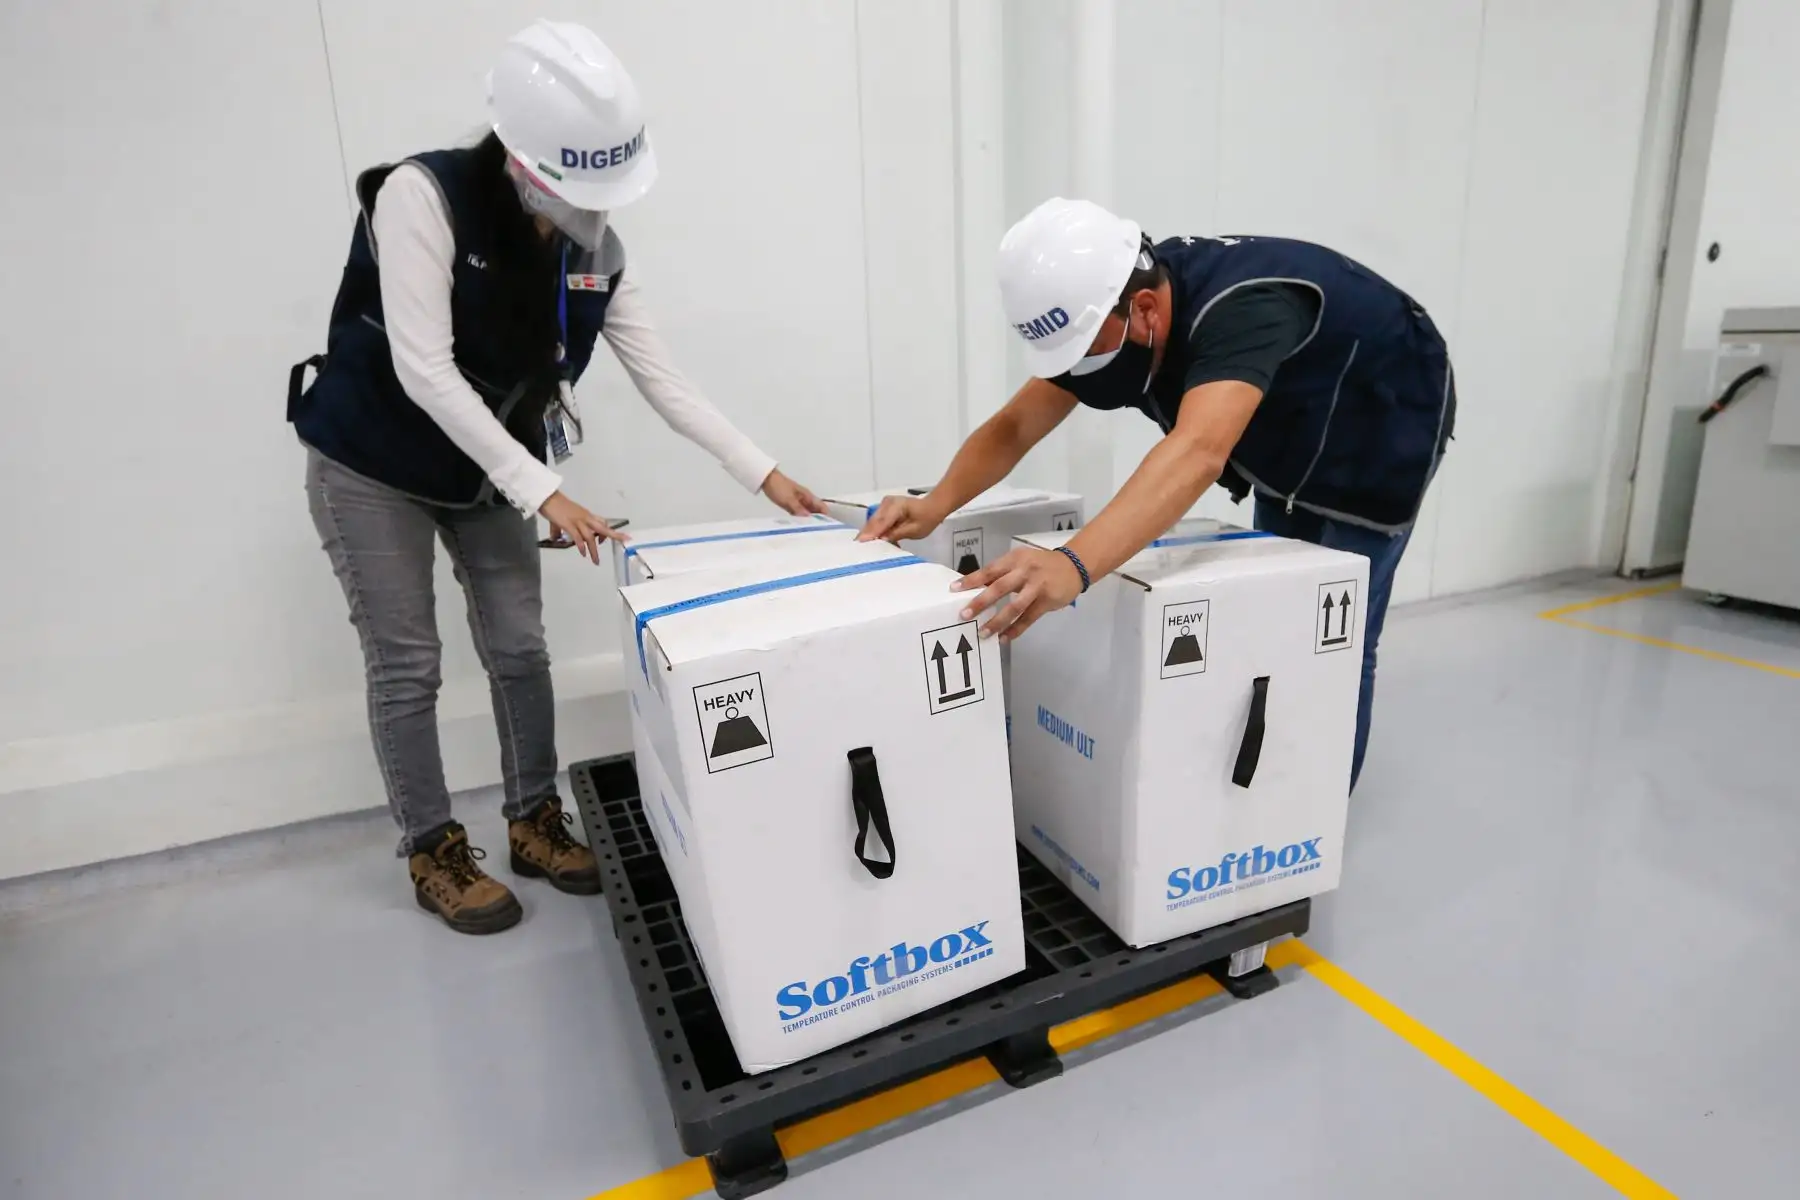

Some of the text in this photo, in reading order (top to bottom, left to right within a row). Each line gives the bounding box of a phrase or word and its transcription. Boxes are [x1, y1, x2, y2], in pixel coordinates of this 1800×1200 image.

[561, 124, 645, 169] DIGEMI
[1013, 307, 1070, 340] EMID
[956, 537, 980, 548] HEAVY
[1168, 612, 1203, 627] HEAVY
[703, 688, 754, 711] HEAVY
[1037, 703, 1074, 748] MEDIUM
[1077, 729, 1095, 761] ULT
[1167, 836, 1323, 900] Softbox
[776, 920, 993, 1021] Softbox
[782, 963, 954, 1034] TEMPERATURE CONTROL PACKAGING SYSTEMS
